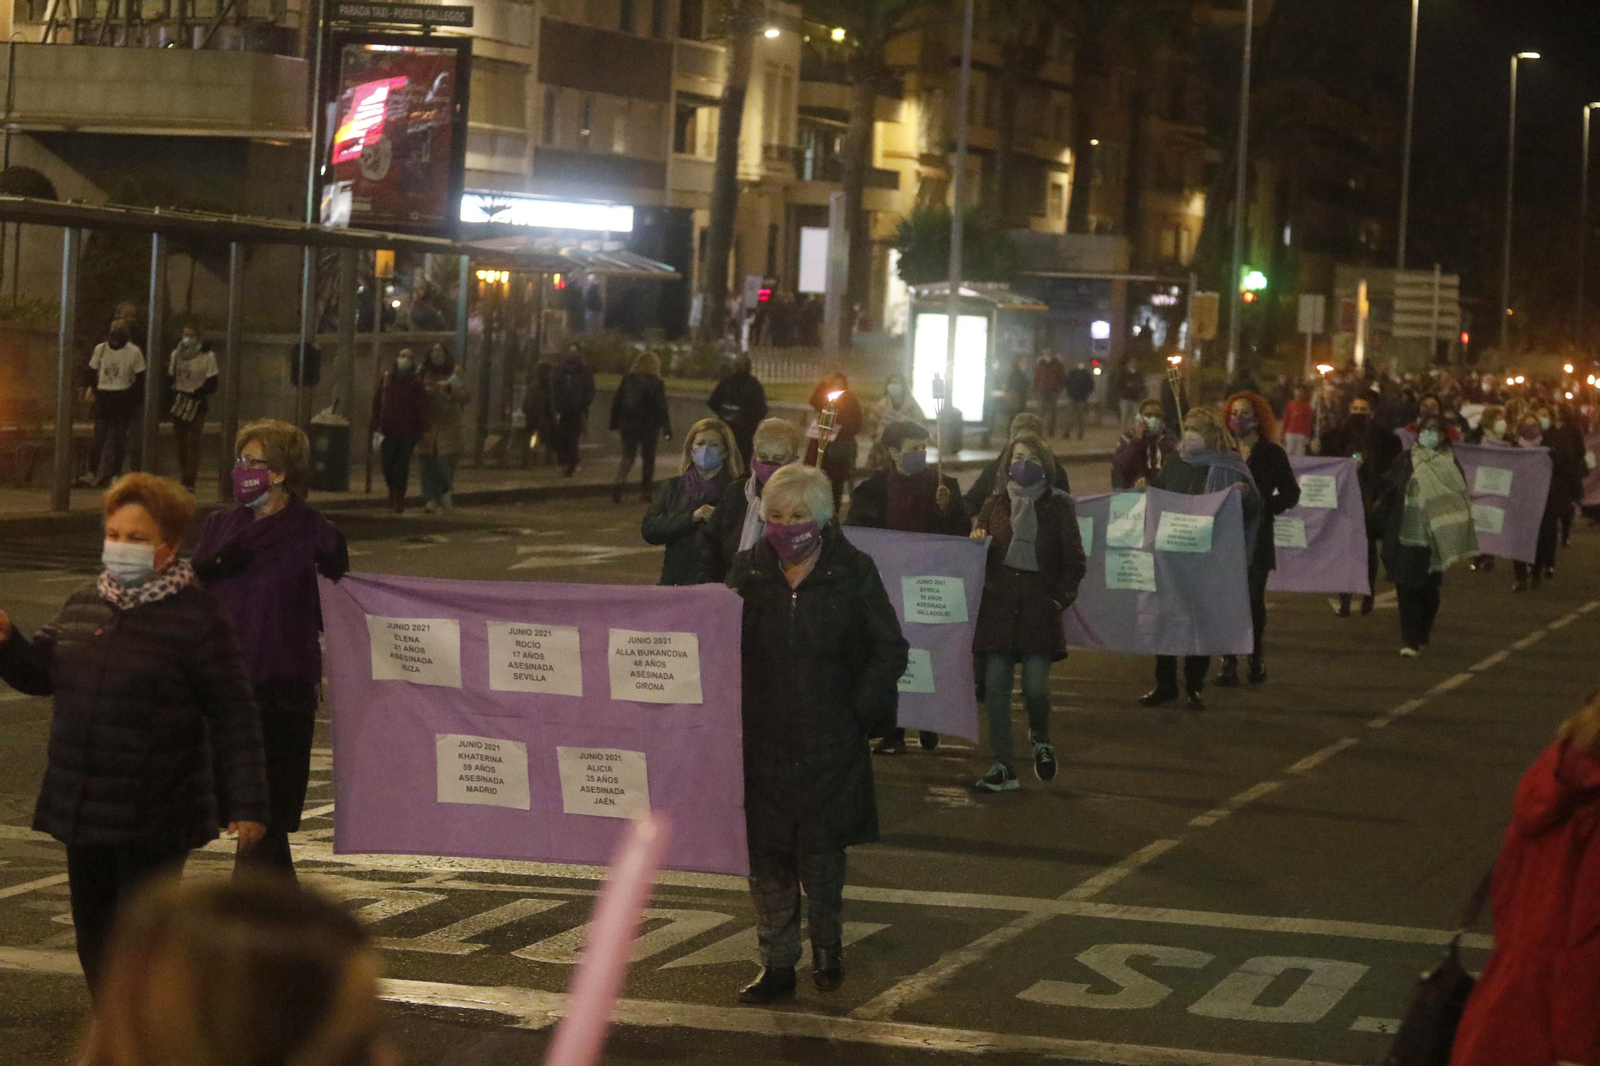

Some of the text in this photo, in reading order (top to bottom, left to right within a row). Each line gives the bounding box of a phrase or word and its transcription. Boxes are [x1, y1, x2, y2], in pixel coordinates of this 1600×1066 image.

[339, 5, 371, 16] PARADA
[372, 6, 388, 17] TAXI
[394, 8, 423, 20] PUERTA
[425, 10, 466, 23] GALLEGOS
[387, 623, 430, 632] JUNIO 2021
[508, 627, 552, 637] JUNIO 2021
[394, 634, 421, 643] ELENA
[627, 637, 651, 645] JUNIO
[403, 644, 426, 654] AÑOS
[637, 649, 688, 658] BUKANCOVA
[389, 652, 433, 665] ASESINADA
[523, 650, 545, 660] AÑOS
[508, 661, 555, 672] ASESINADA
[644, 659, 667, 668] AÑOS
[401, 664, 421, 673] IBIZA
[513, 673, 547, 682] SEVILLA
[630, 671, 674, 680] ASESINADA
[635, 682, 664, 691] GIRONA
[458, 741, 500, 751] JUNIO 2021
[458, 753, 503, 764] KHATERINA
[579, 752, 603, 760] JUNIO
[474, 764, 496, 773] AÑOS
[458, 774, 505, 785] ASESINADA
[597, 775, 619, 784] AÑOS
[466, 786, 498, 795] MADRID
[580, 785, 625, 795] ASESINADA
